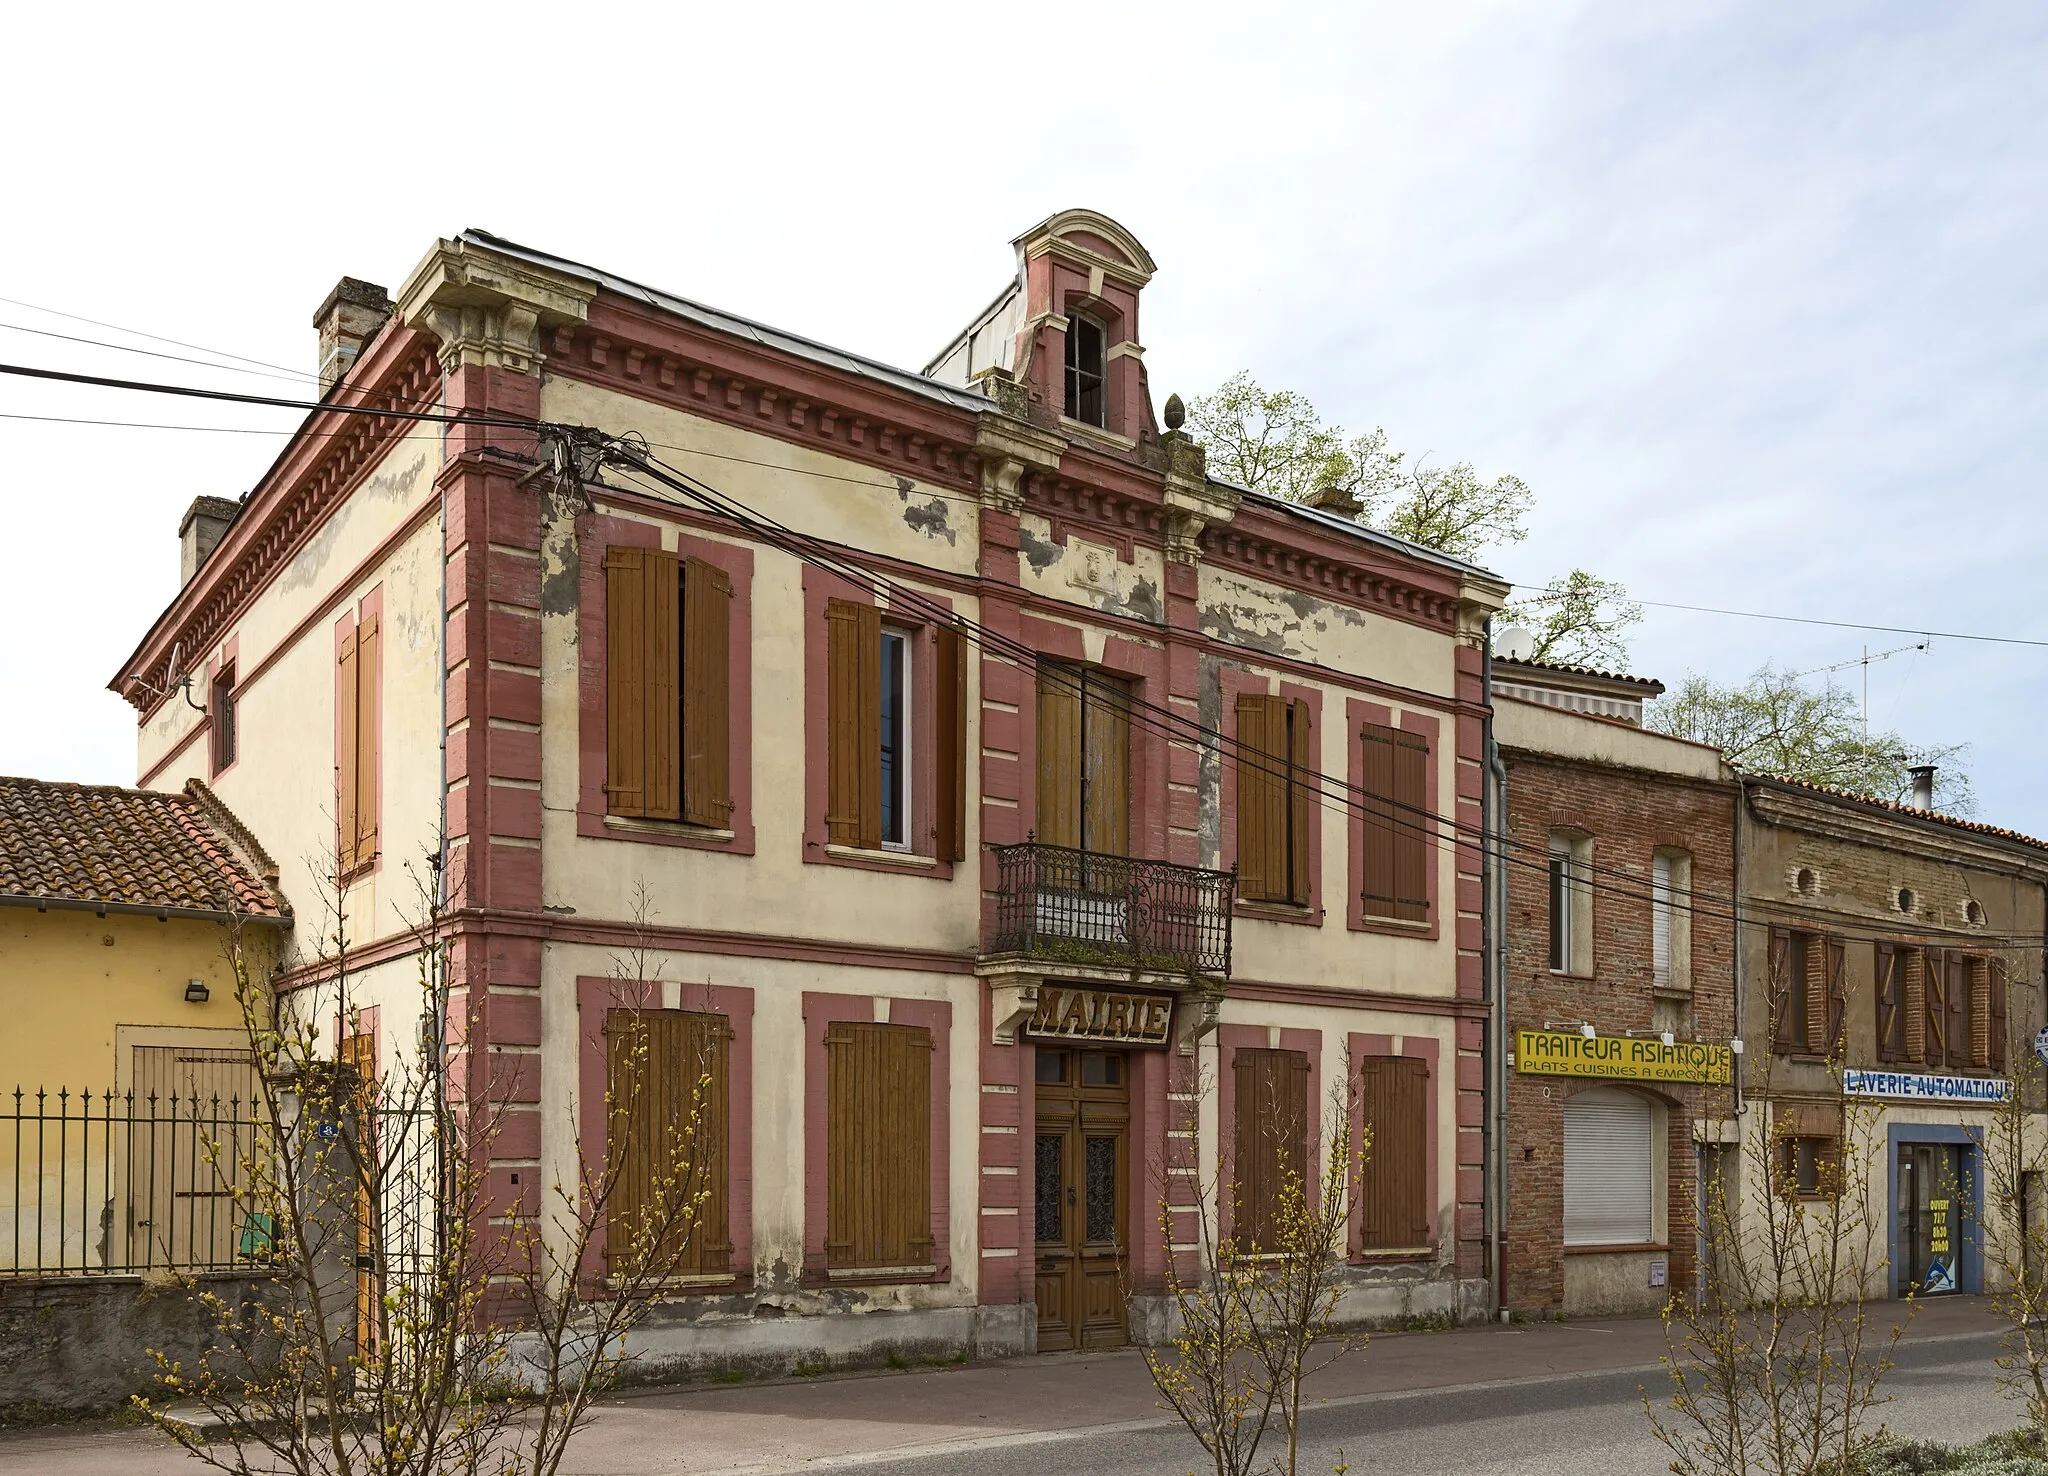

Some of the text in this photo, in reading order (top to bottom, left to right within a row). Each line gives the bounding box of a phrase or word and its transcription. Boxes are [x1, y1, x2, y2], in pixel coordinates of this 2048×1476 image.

[1029, 988, 1169, 1040] MAIRIE
[1522, 1033, 1622, 1061] TRAITEUR
[1631, 1041, 1729, 1069] ASIATIQUE
[1523, 1060, 1569, 1072] PLATS
[1573, 1063, 1637, 1077] CUISINES
[1642, 1068, 1651, 1077] A
[1847, 1071, 1912, 1095] LAVERIE
[1929, 1199, 1950, 1211] OUVERT
[1932, 1225, 1947, 1239] 8h30
